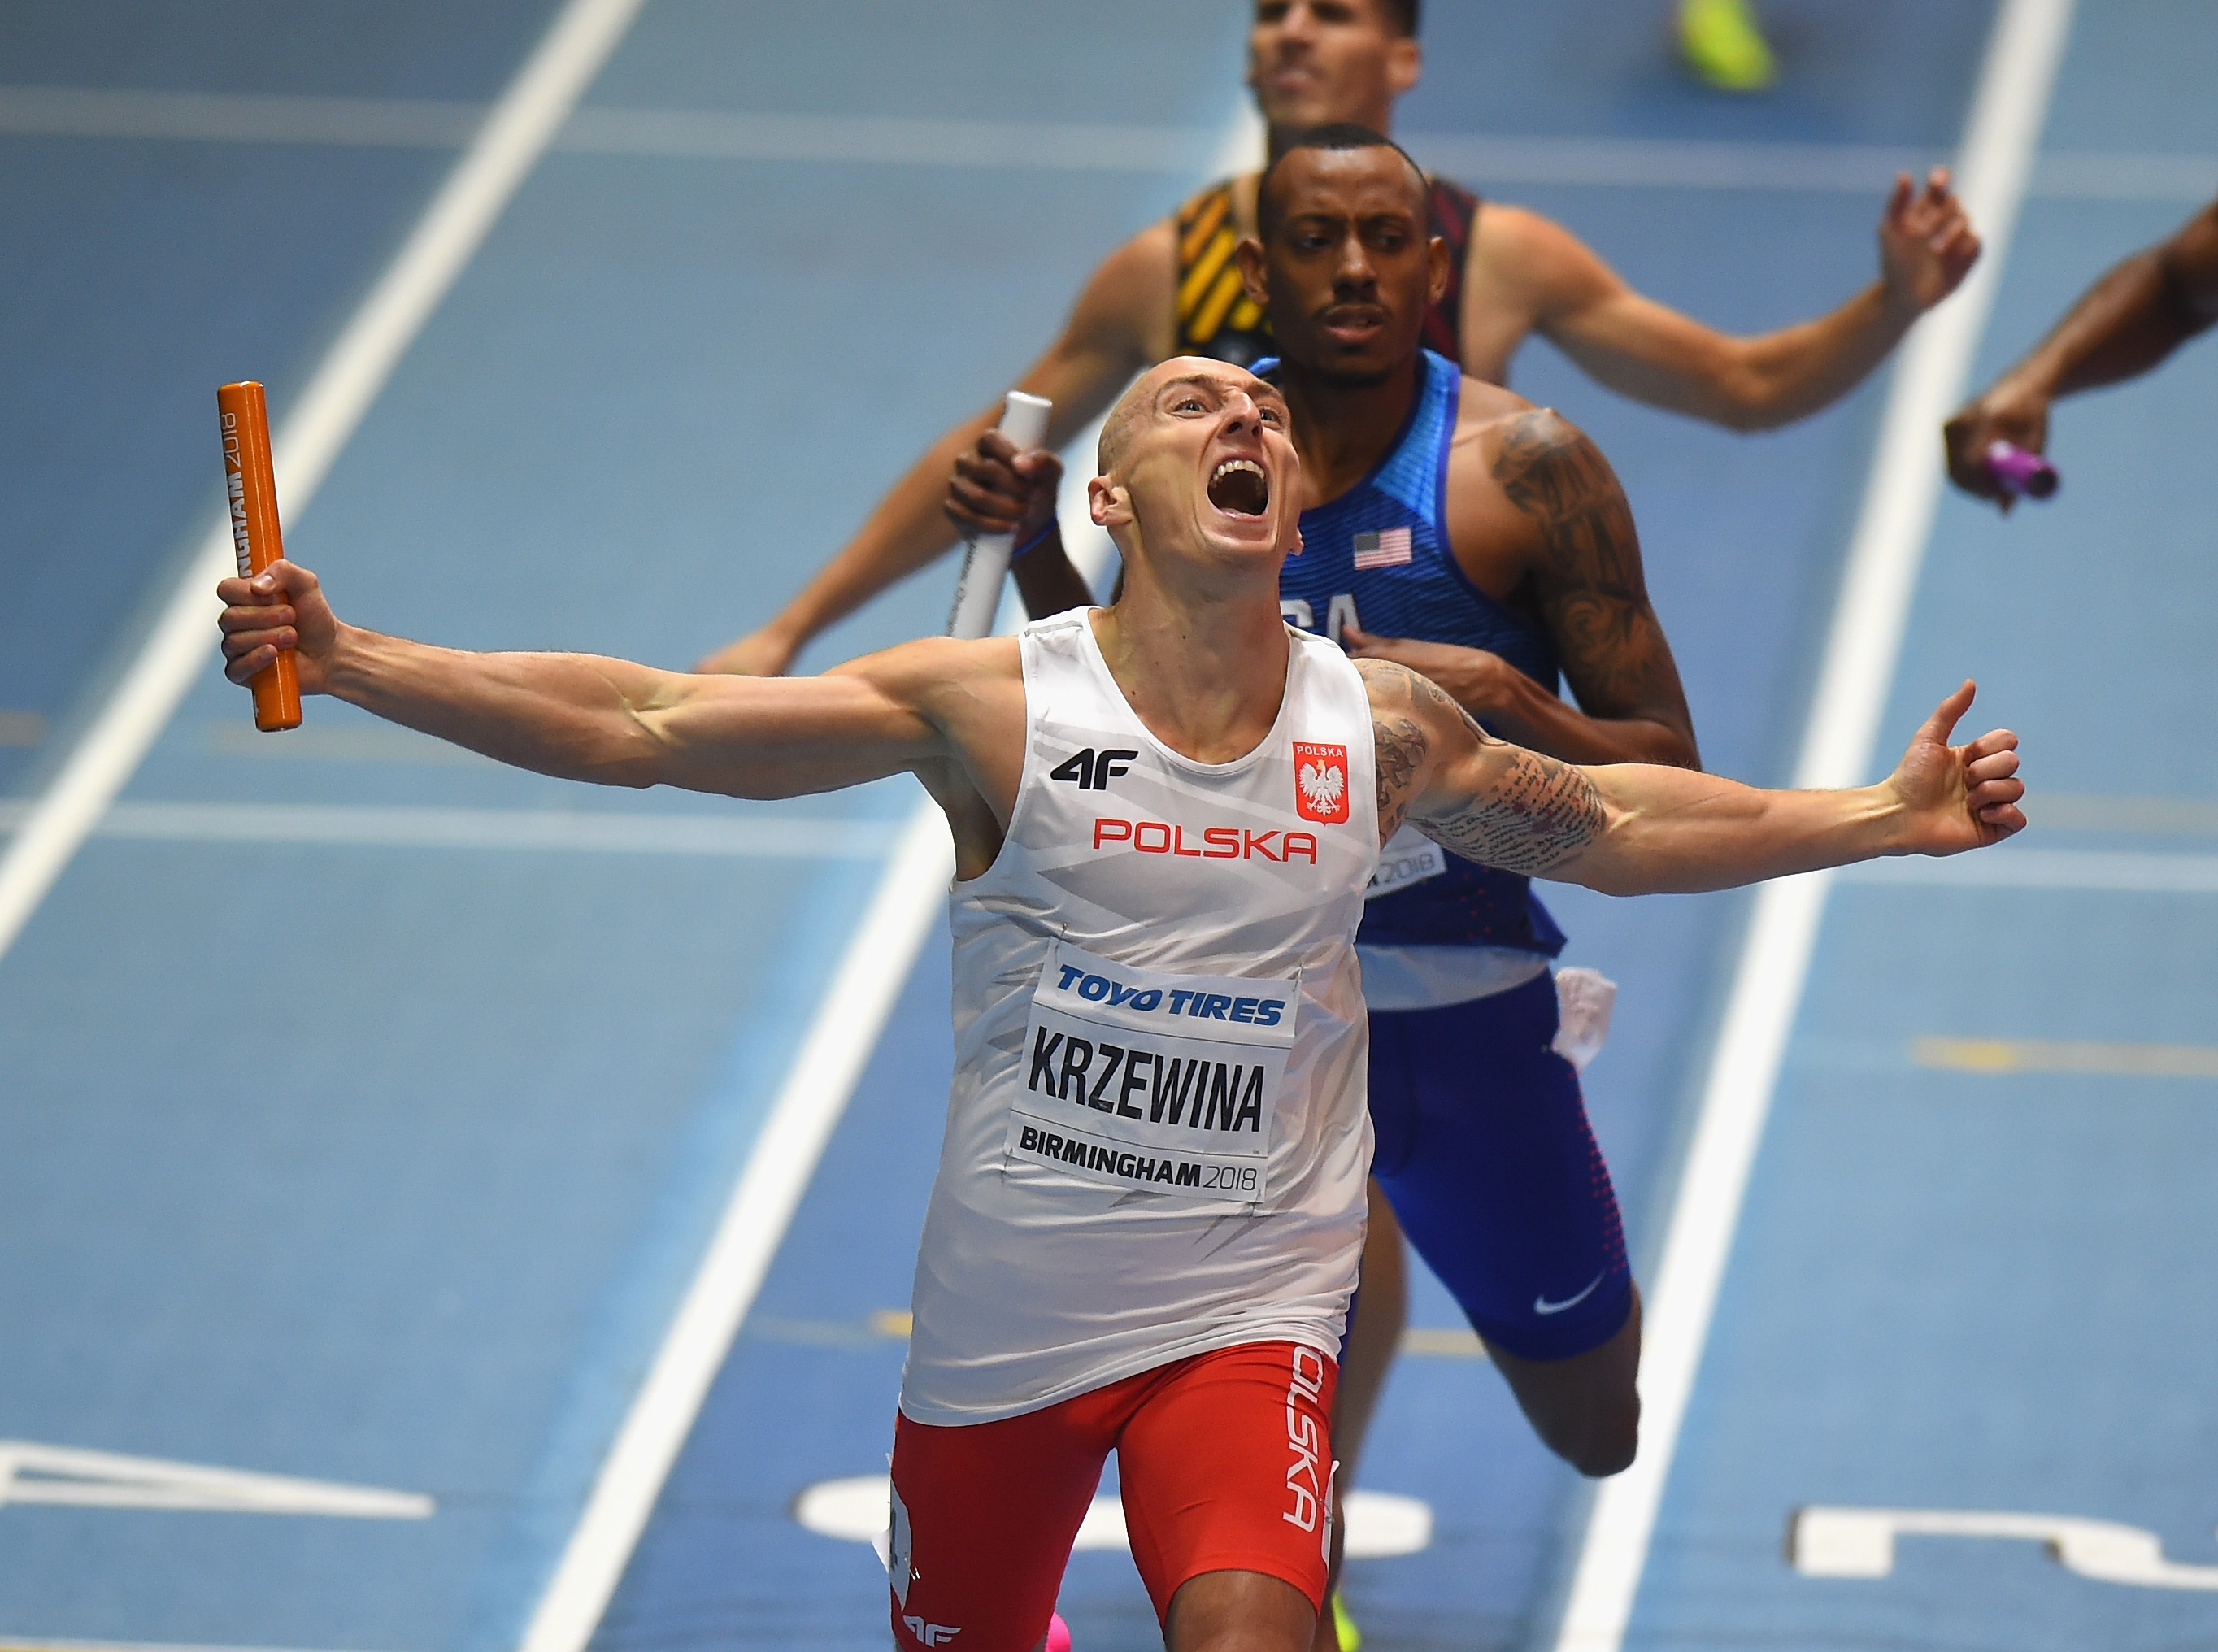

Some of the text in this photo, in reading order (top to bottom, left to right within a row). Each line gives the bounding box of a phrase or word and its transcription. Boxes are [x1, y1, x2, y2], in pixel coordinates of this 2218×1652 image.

[221, 411, 242, 469] 2018
[1050, 748, 1139, 791] 4F
[1296, 745, 1344, 759] POLSKA
[1093, 818, 1318, 865] POLSKA
[1056, 963, 1286, 1027] TOYO TIRES
[1028, 1025, 1266, 1133] KRZEWINA
[1019, 1124, 1257, 1191] BIRMINGHAM 2018
